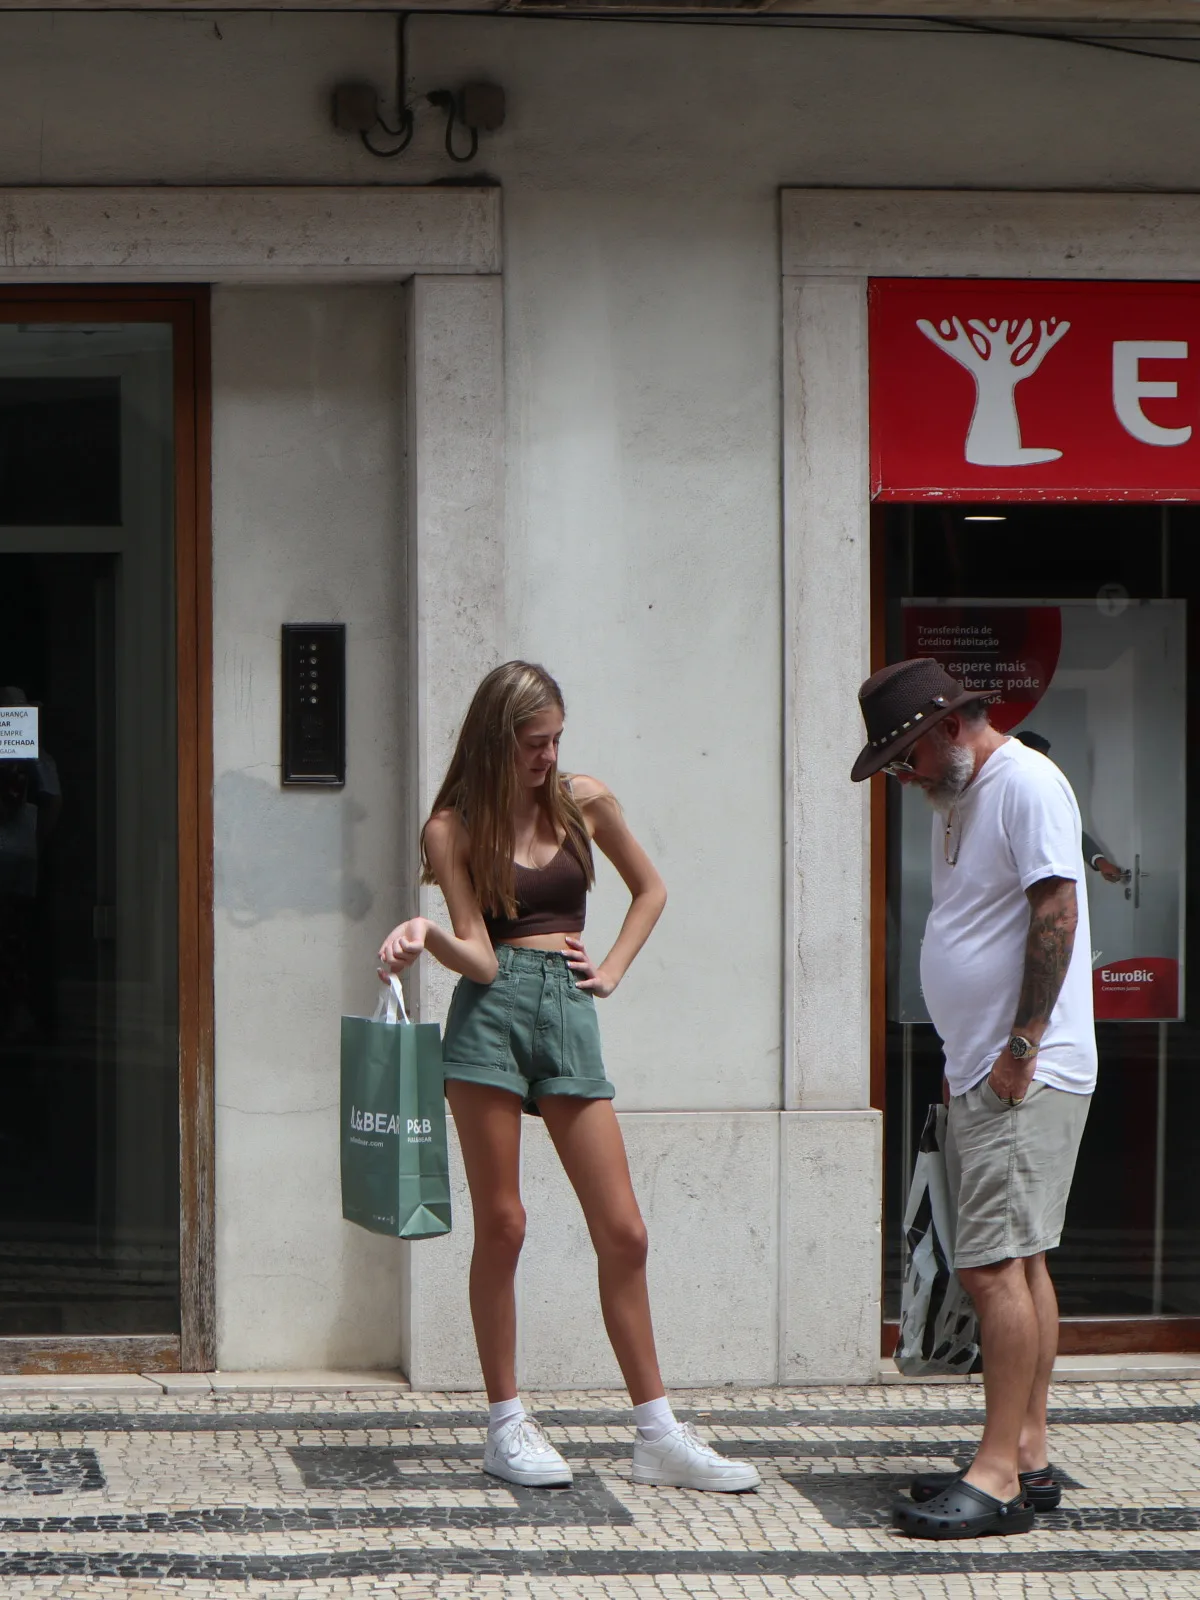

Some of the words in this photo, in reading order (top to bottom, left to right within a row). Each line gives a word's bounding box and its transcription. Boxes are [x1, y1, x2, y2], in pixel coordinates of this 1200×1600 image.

[1113, 340, 1192, 447] E
[918, 625, 979, 635] Transferência
[981, 625, 992, 635] de
[918, 637, 951, 646] Crédito
[953, 637, 999, 648] Habitação
[949, 661, 992, 674] espere
[995, 659, 1026, 672] mais
[957, 677, 988, 688] aber
[990, 680, 1003, 688] se
[1007, 677, 1040, 691] pode
[1101, 969, 1154, 982] EuroBic
[407, 1118, 432, 1134] P&B
